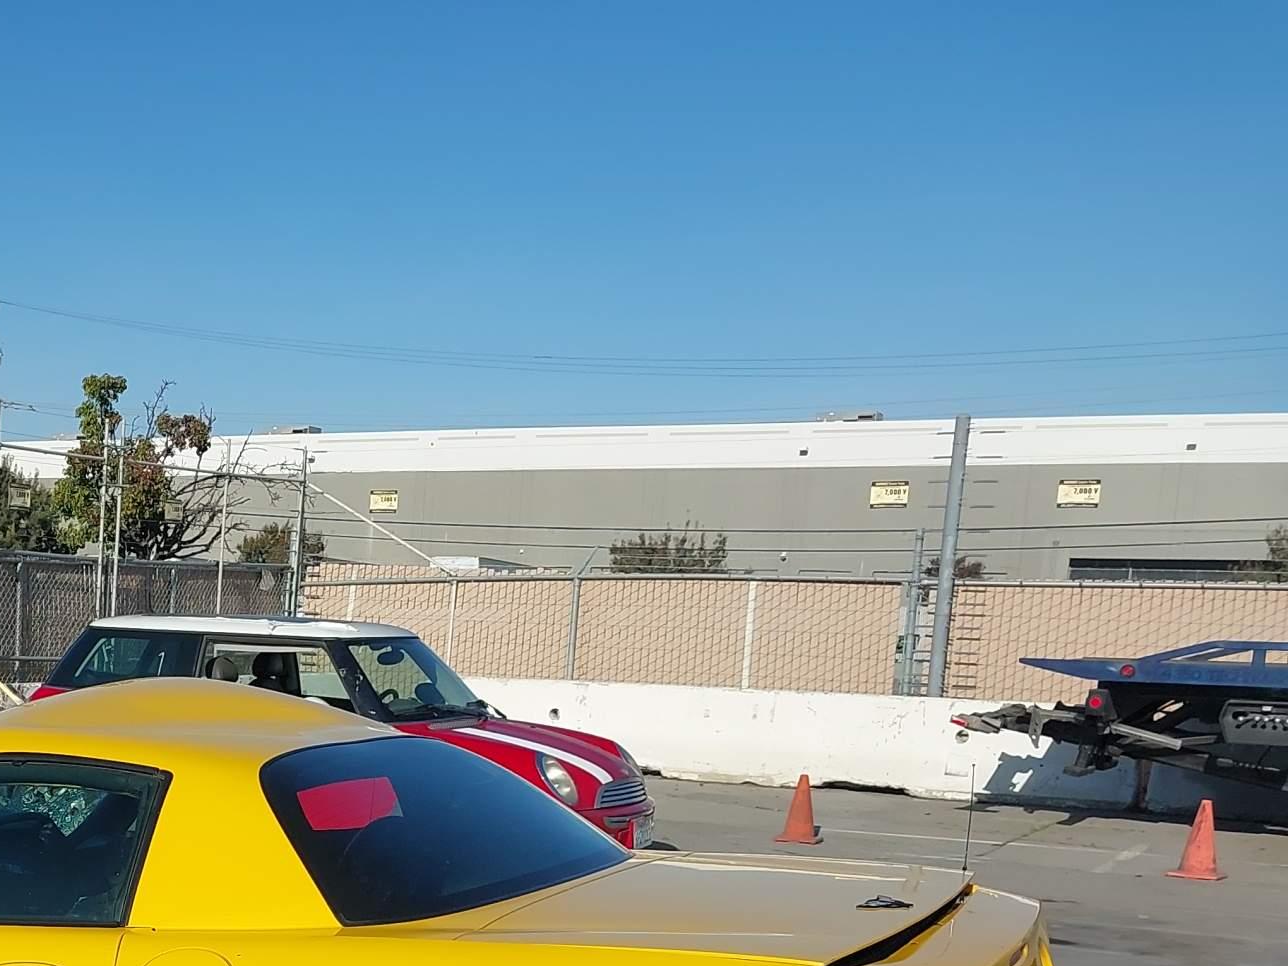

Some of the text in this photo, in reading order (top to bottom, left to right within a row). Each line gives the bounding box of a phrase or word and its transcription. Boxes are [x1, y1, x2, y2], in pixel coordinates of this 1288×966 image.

[884, 488, 902, 496] 7,000
[1073, 487, 1099, 496] 7,000 V
